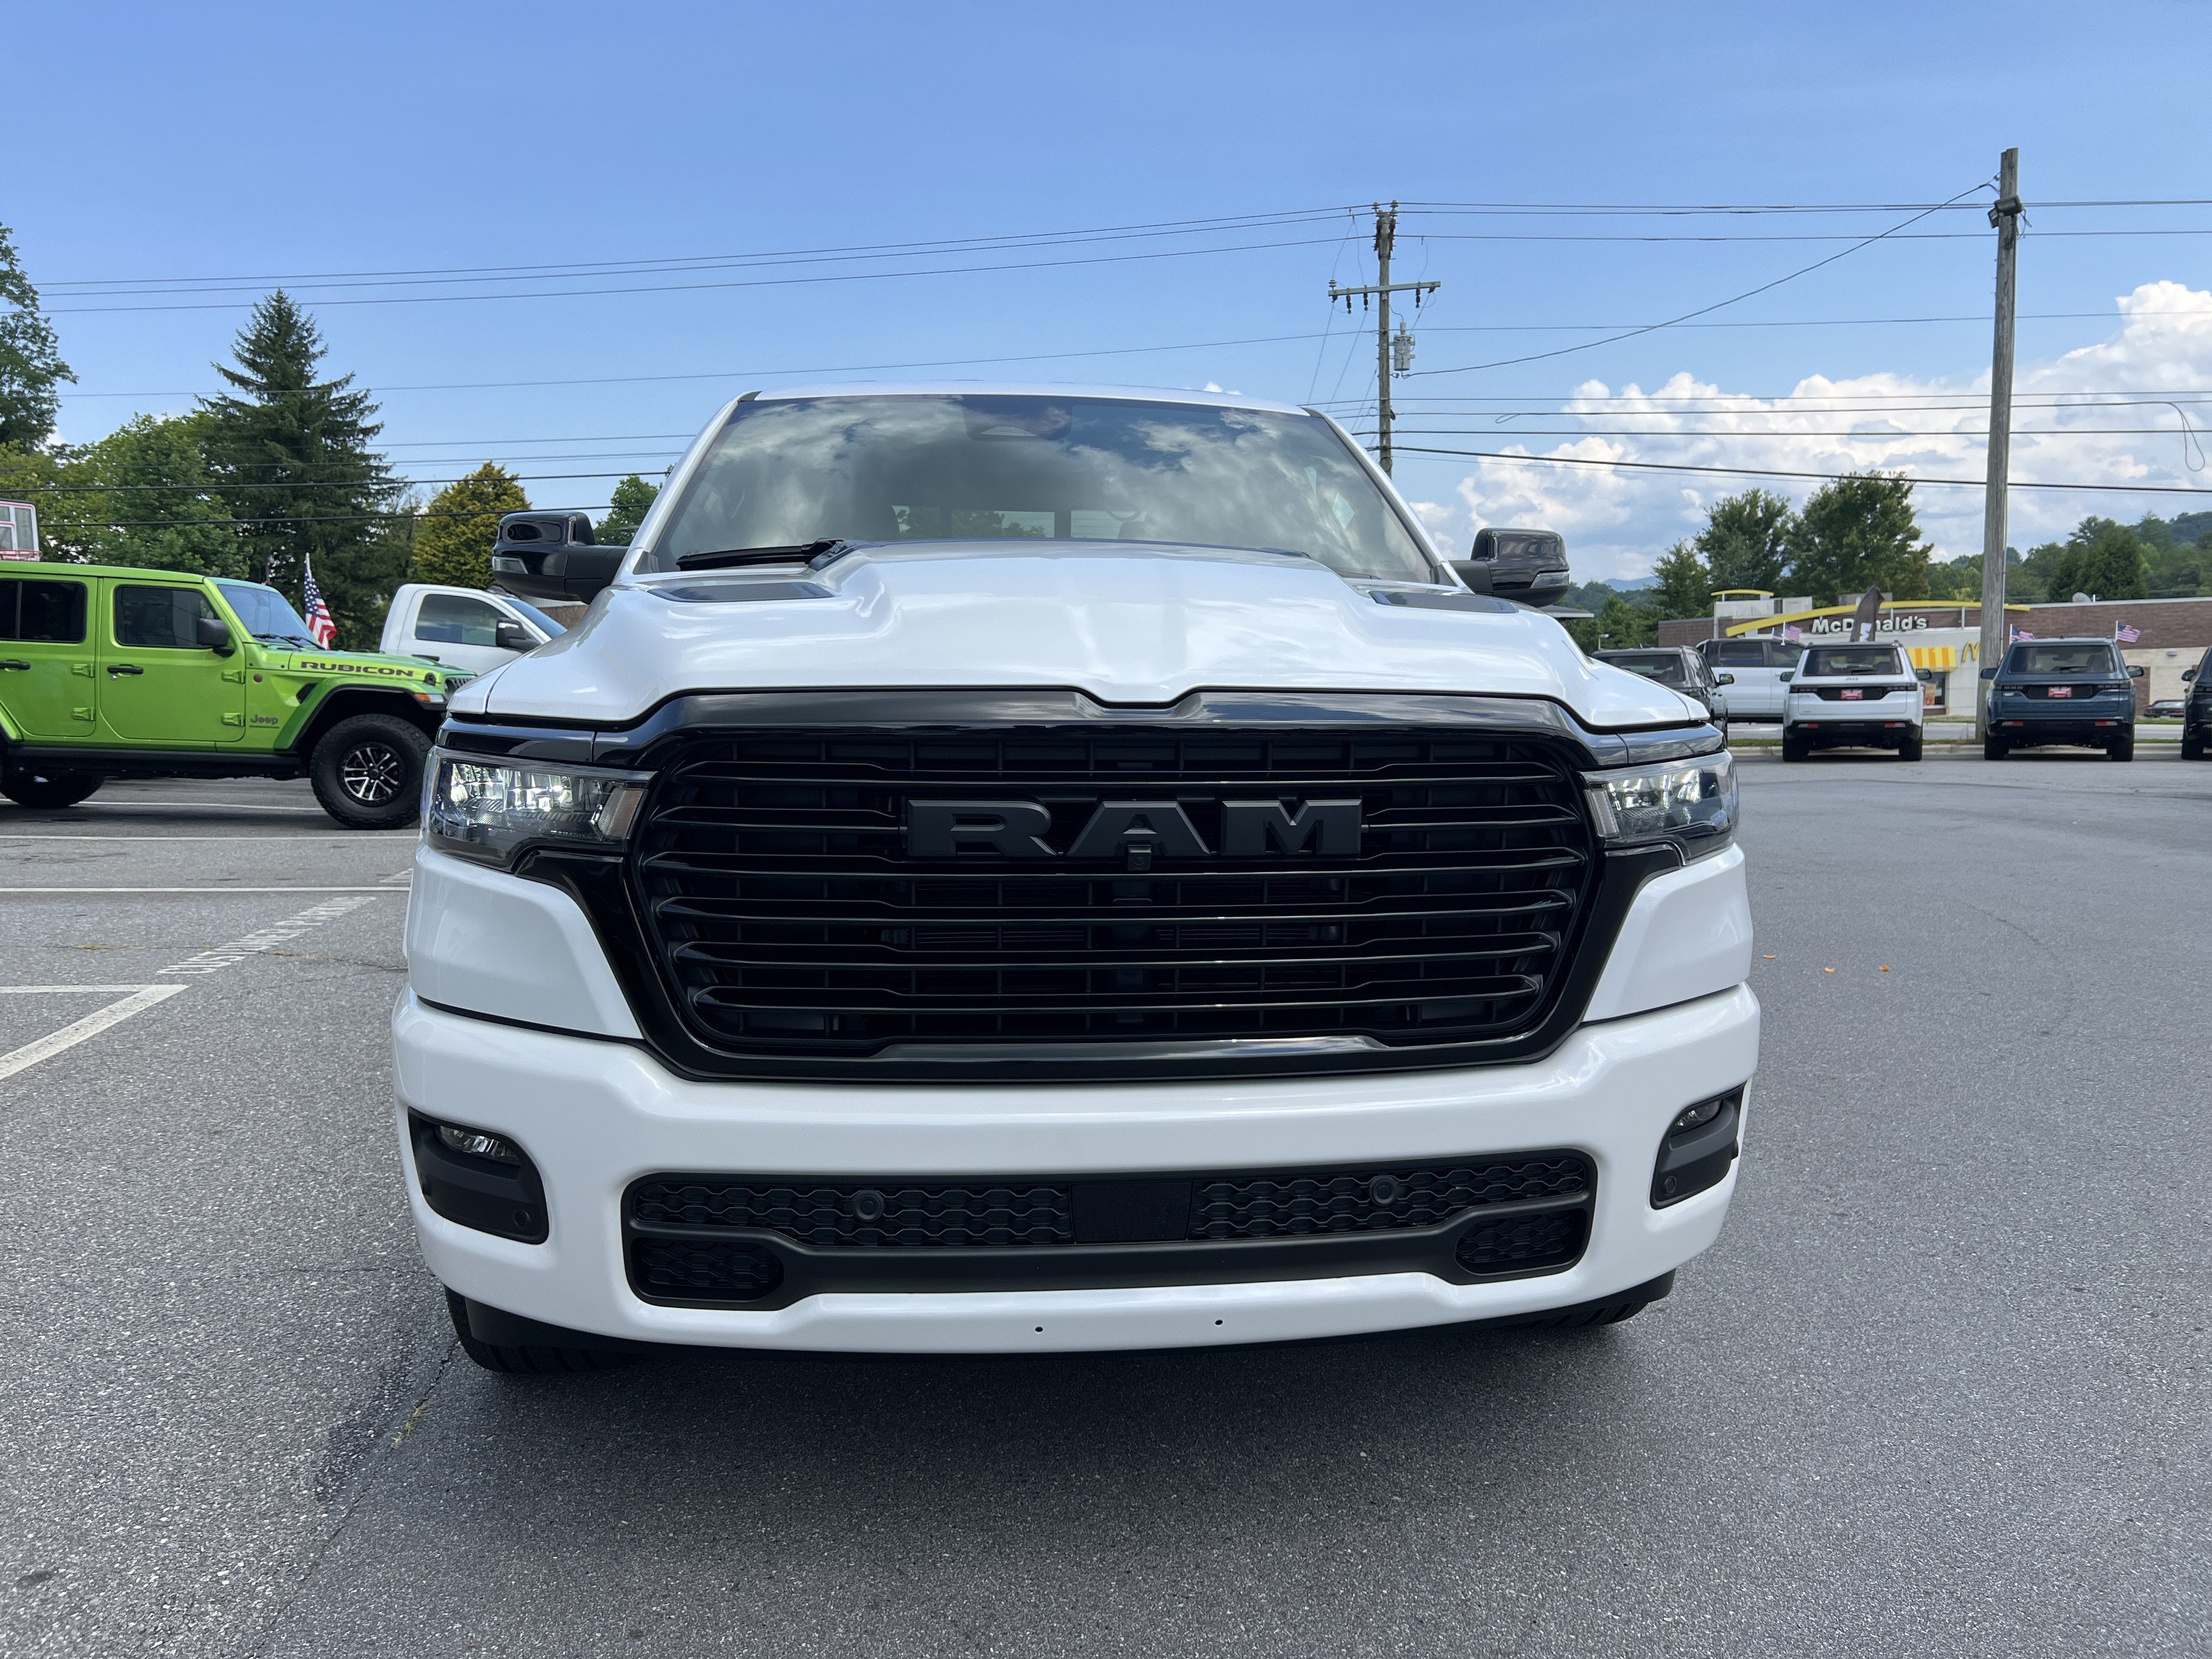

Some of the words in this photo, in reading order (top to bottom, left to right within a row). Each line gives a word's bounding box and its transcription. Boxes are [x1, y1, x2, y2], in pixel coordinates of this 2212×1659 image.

[1812, 616, 1928, 634] McDnald's
[301, 661, 414, 676] RUBICON
[251, 714, 278, 725] Jeep
[907, 799, 1362, 856] RAM
